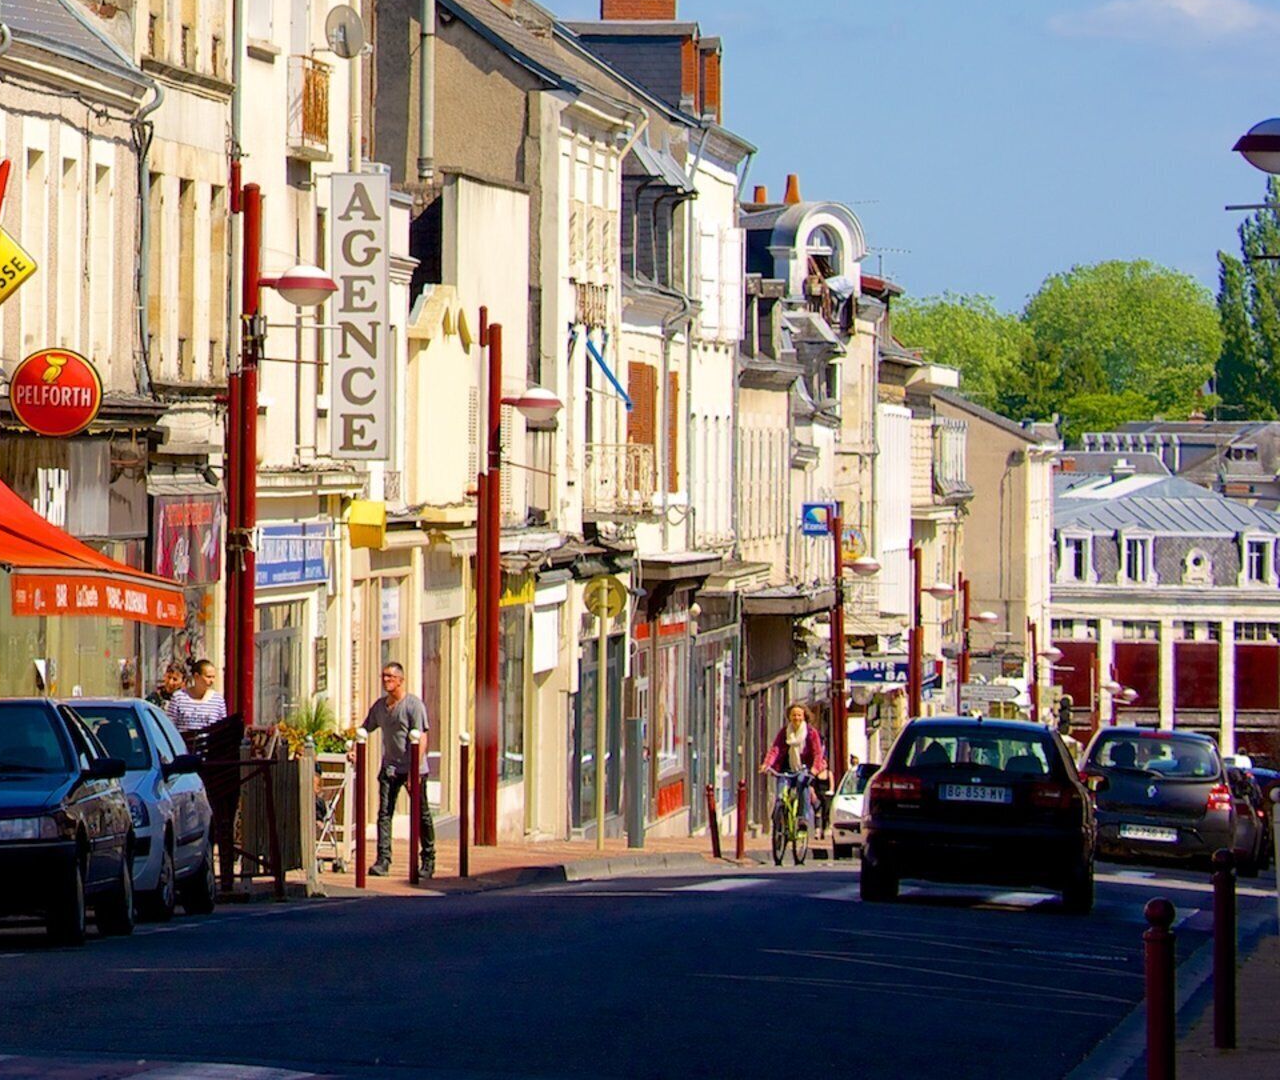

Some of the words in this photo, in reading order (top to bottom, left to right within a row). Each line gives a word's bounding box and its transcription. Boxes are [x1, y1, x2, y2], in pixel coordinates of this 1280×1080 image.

[337, 181, 381, 452] AGENCE
[16, 384, 92, 408] PELFORTH
[858, 660, 896, 671] ARIS
